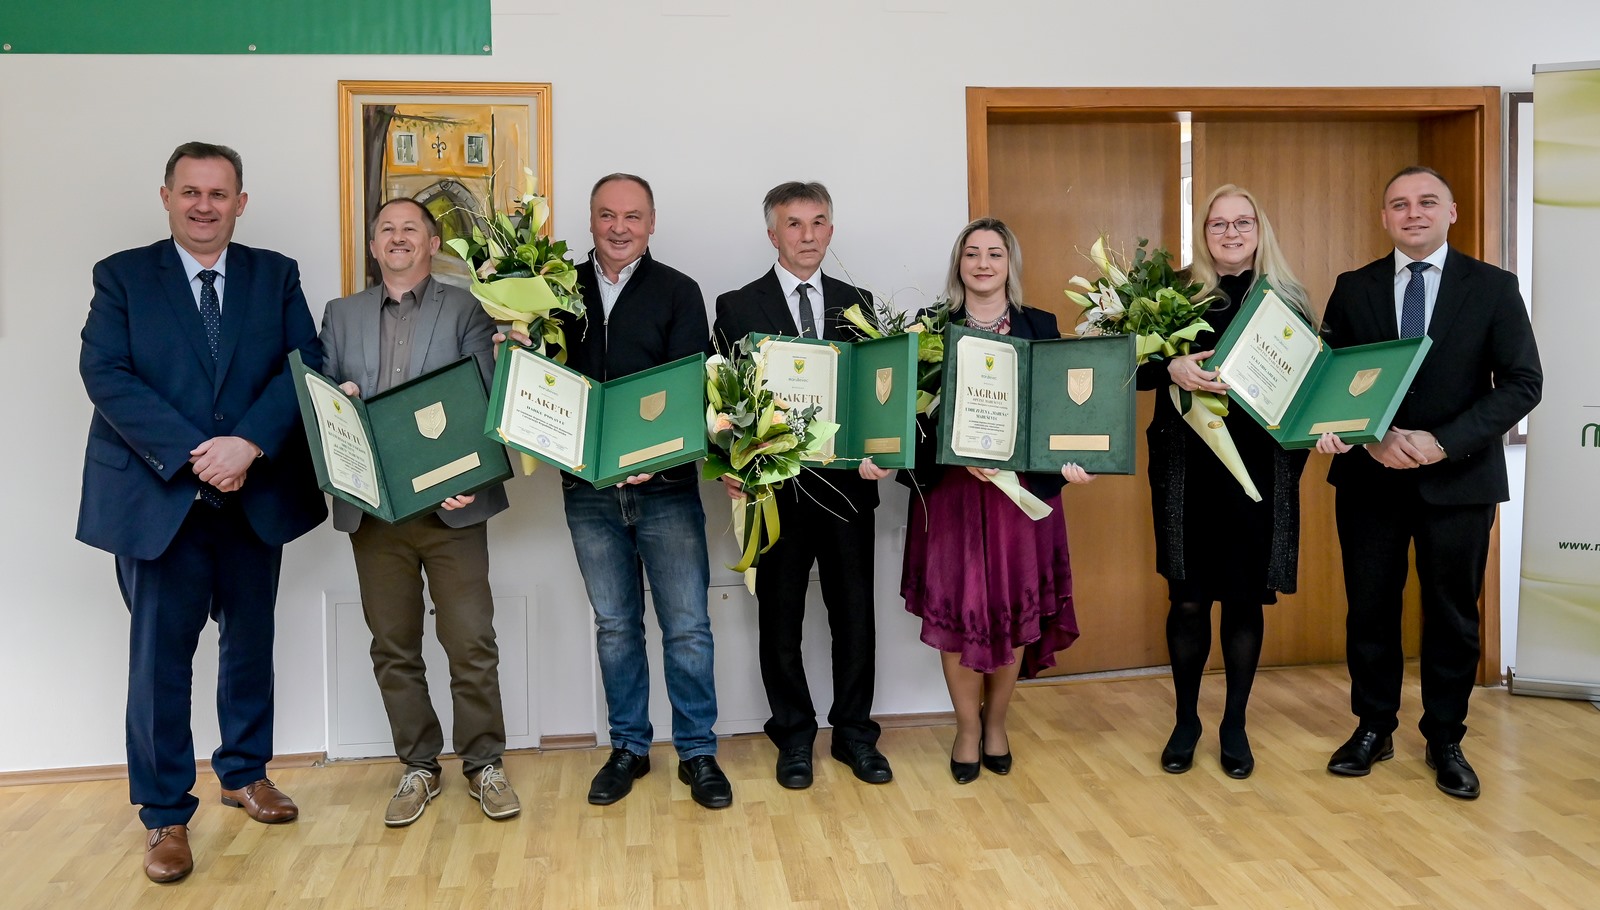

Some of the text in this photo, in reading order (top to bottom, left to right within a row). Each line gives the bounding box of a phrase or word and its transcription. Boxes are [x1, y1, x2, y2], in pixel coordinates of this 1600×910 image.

[1253, 333, 1295, 376] NAGRADU
[520, 389, 573, 419] PLAKETU
[967, 386, 1009, 402] NAGRADU
[326, 419, 362, 447] PLAKETU
